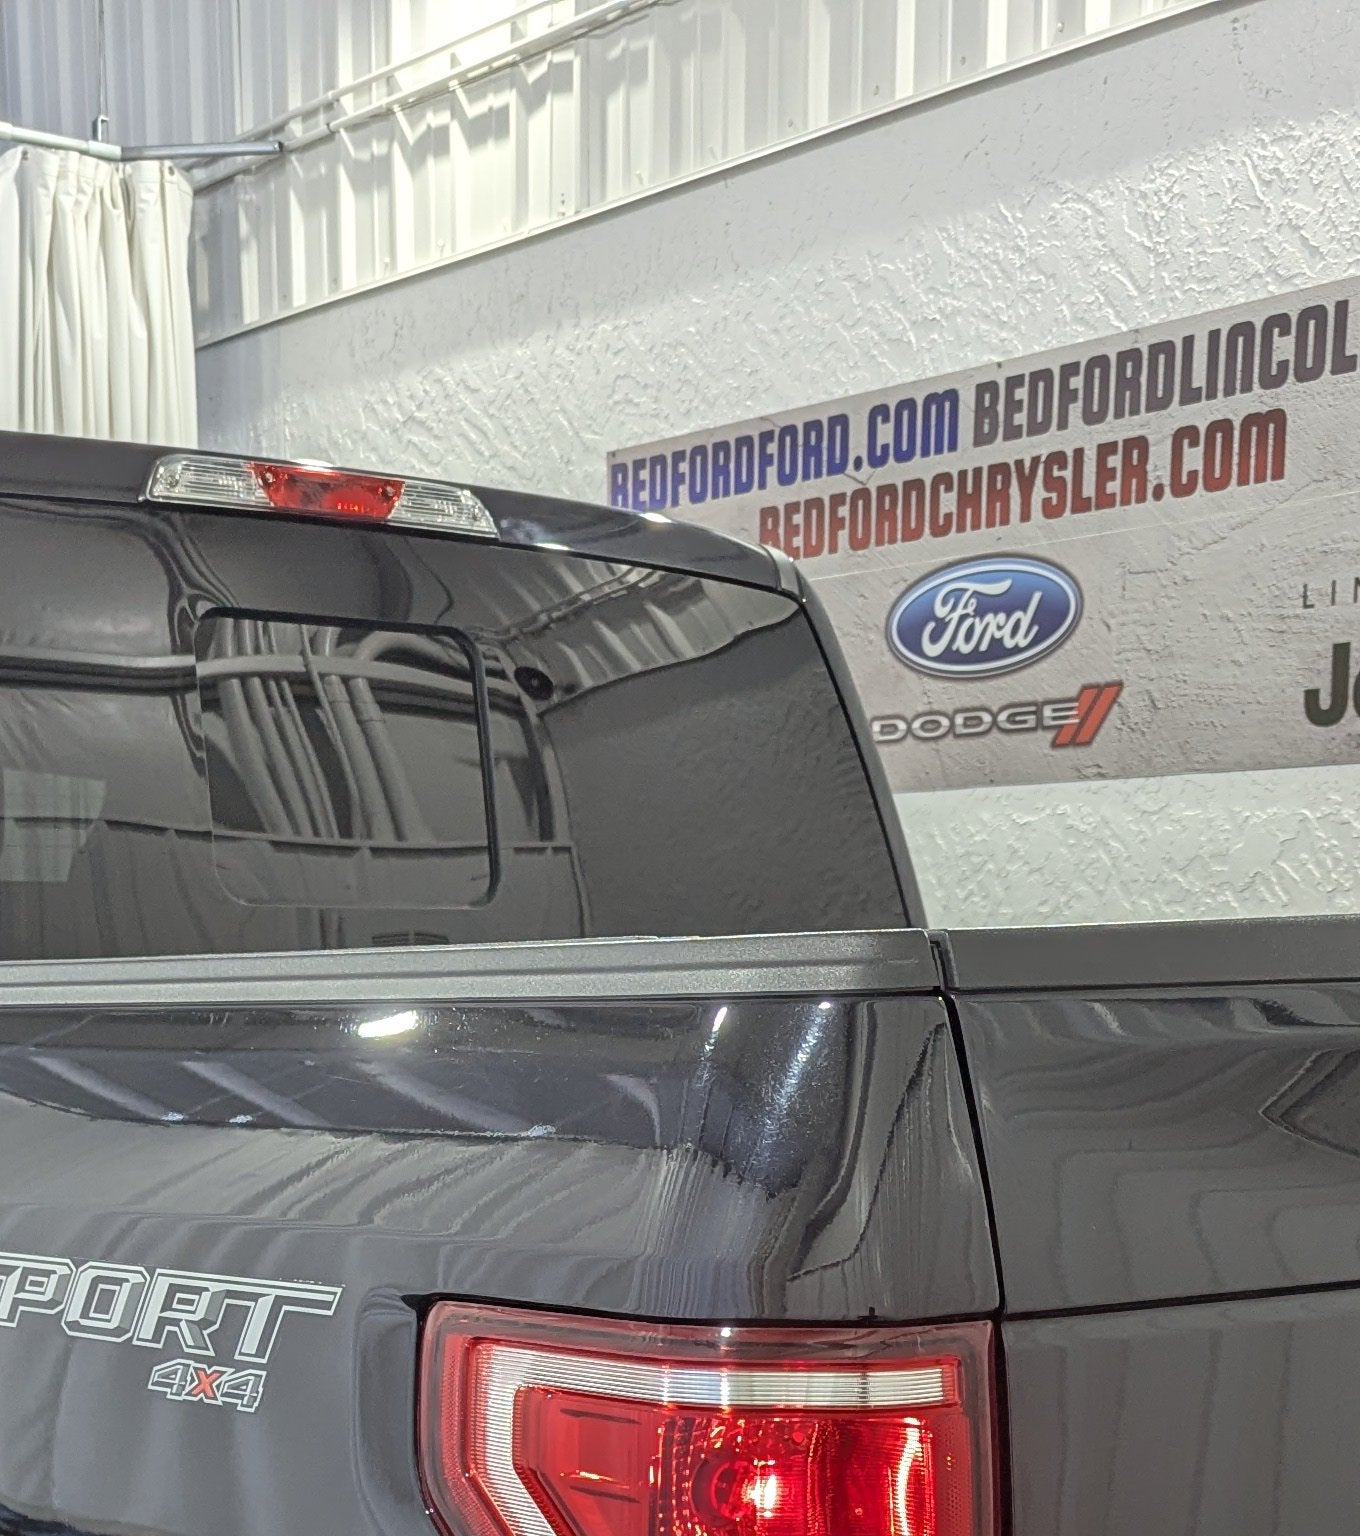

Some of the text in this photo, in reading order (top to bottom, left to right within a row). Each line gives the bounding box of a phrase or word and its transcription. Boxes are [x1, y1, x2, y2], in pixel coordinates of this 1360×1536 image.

[610, 386, 960, 513] BEDFORDFORD.COM
[759, 406, 1288, 560] BEDFORDCHRYSLER.COM
[921, 578, 1043, 658] Ford
[870, 700, 1081, 744] DODGE
